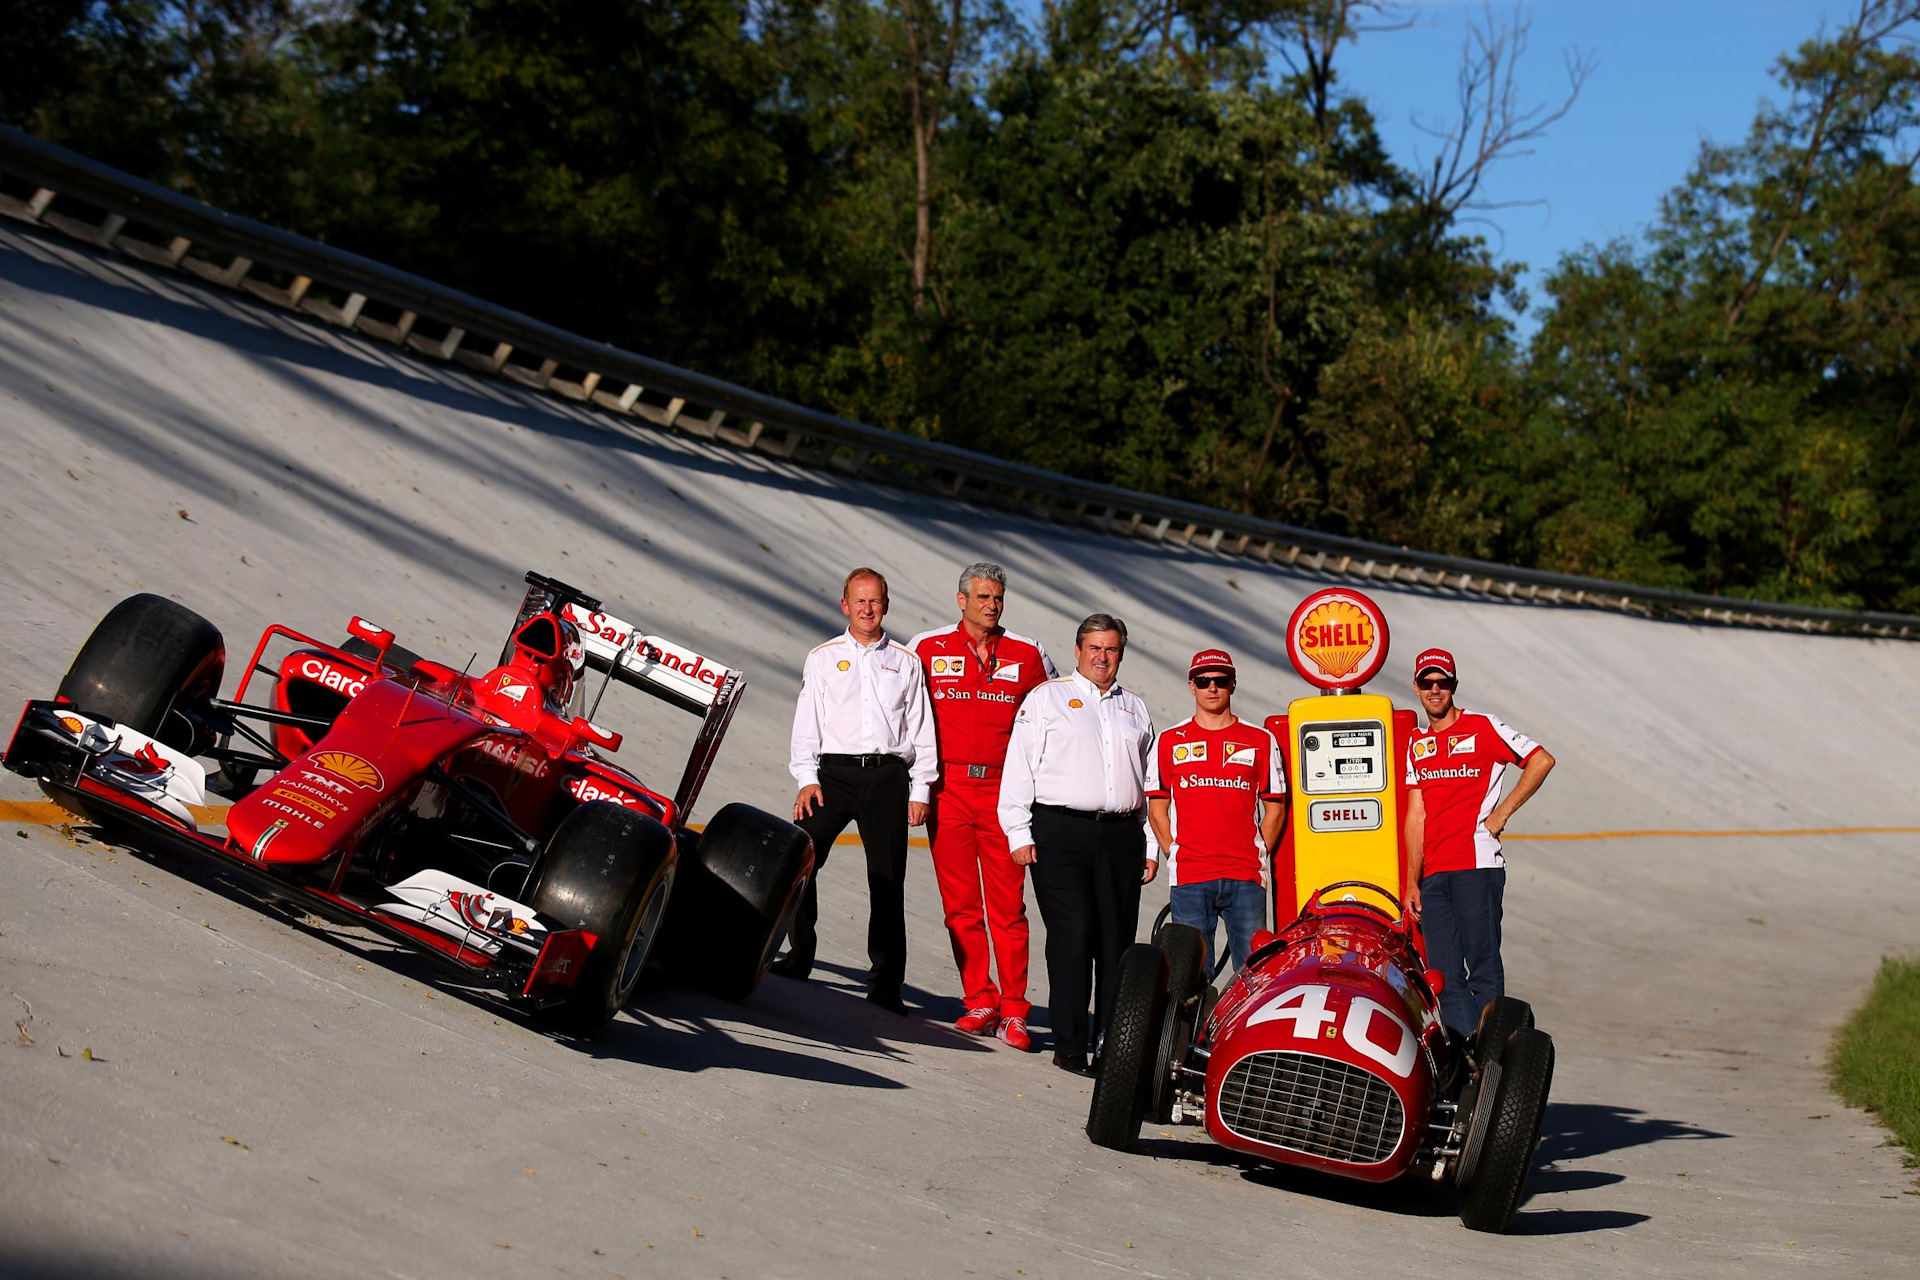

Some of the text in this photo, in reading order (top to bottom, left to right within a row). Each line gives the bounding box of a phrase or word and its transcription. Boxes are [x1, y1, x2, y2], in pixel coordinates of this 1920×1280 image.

[1305, 623, 1368, 648] SHELL
[584, 611, 724, 689] Santander
[302, 660, 367, 698] Claro
[300, 770, 354, 794] TNT
[1189, 774, 1251, 790] Santander
[1421, 764, 1480, 780] Santander
[279, 779, 344, 807] KASPERSKY
[262, 799, 325, 829] MAHLE
[1323, 809, 1368, 821] SHELL
[1246, 984, 1418, 1078] 40
